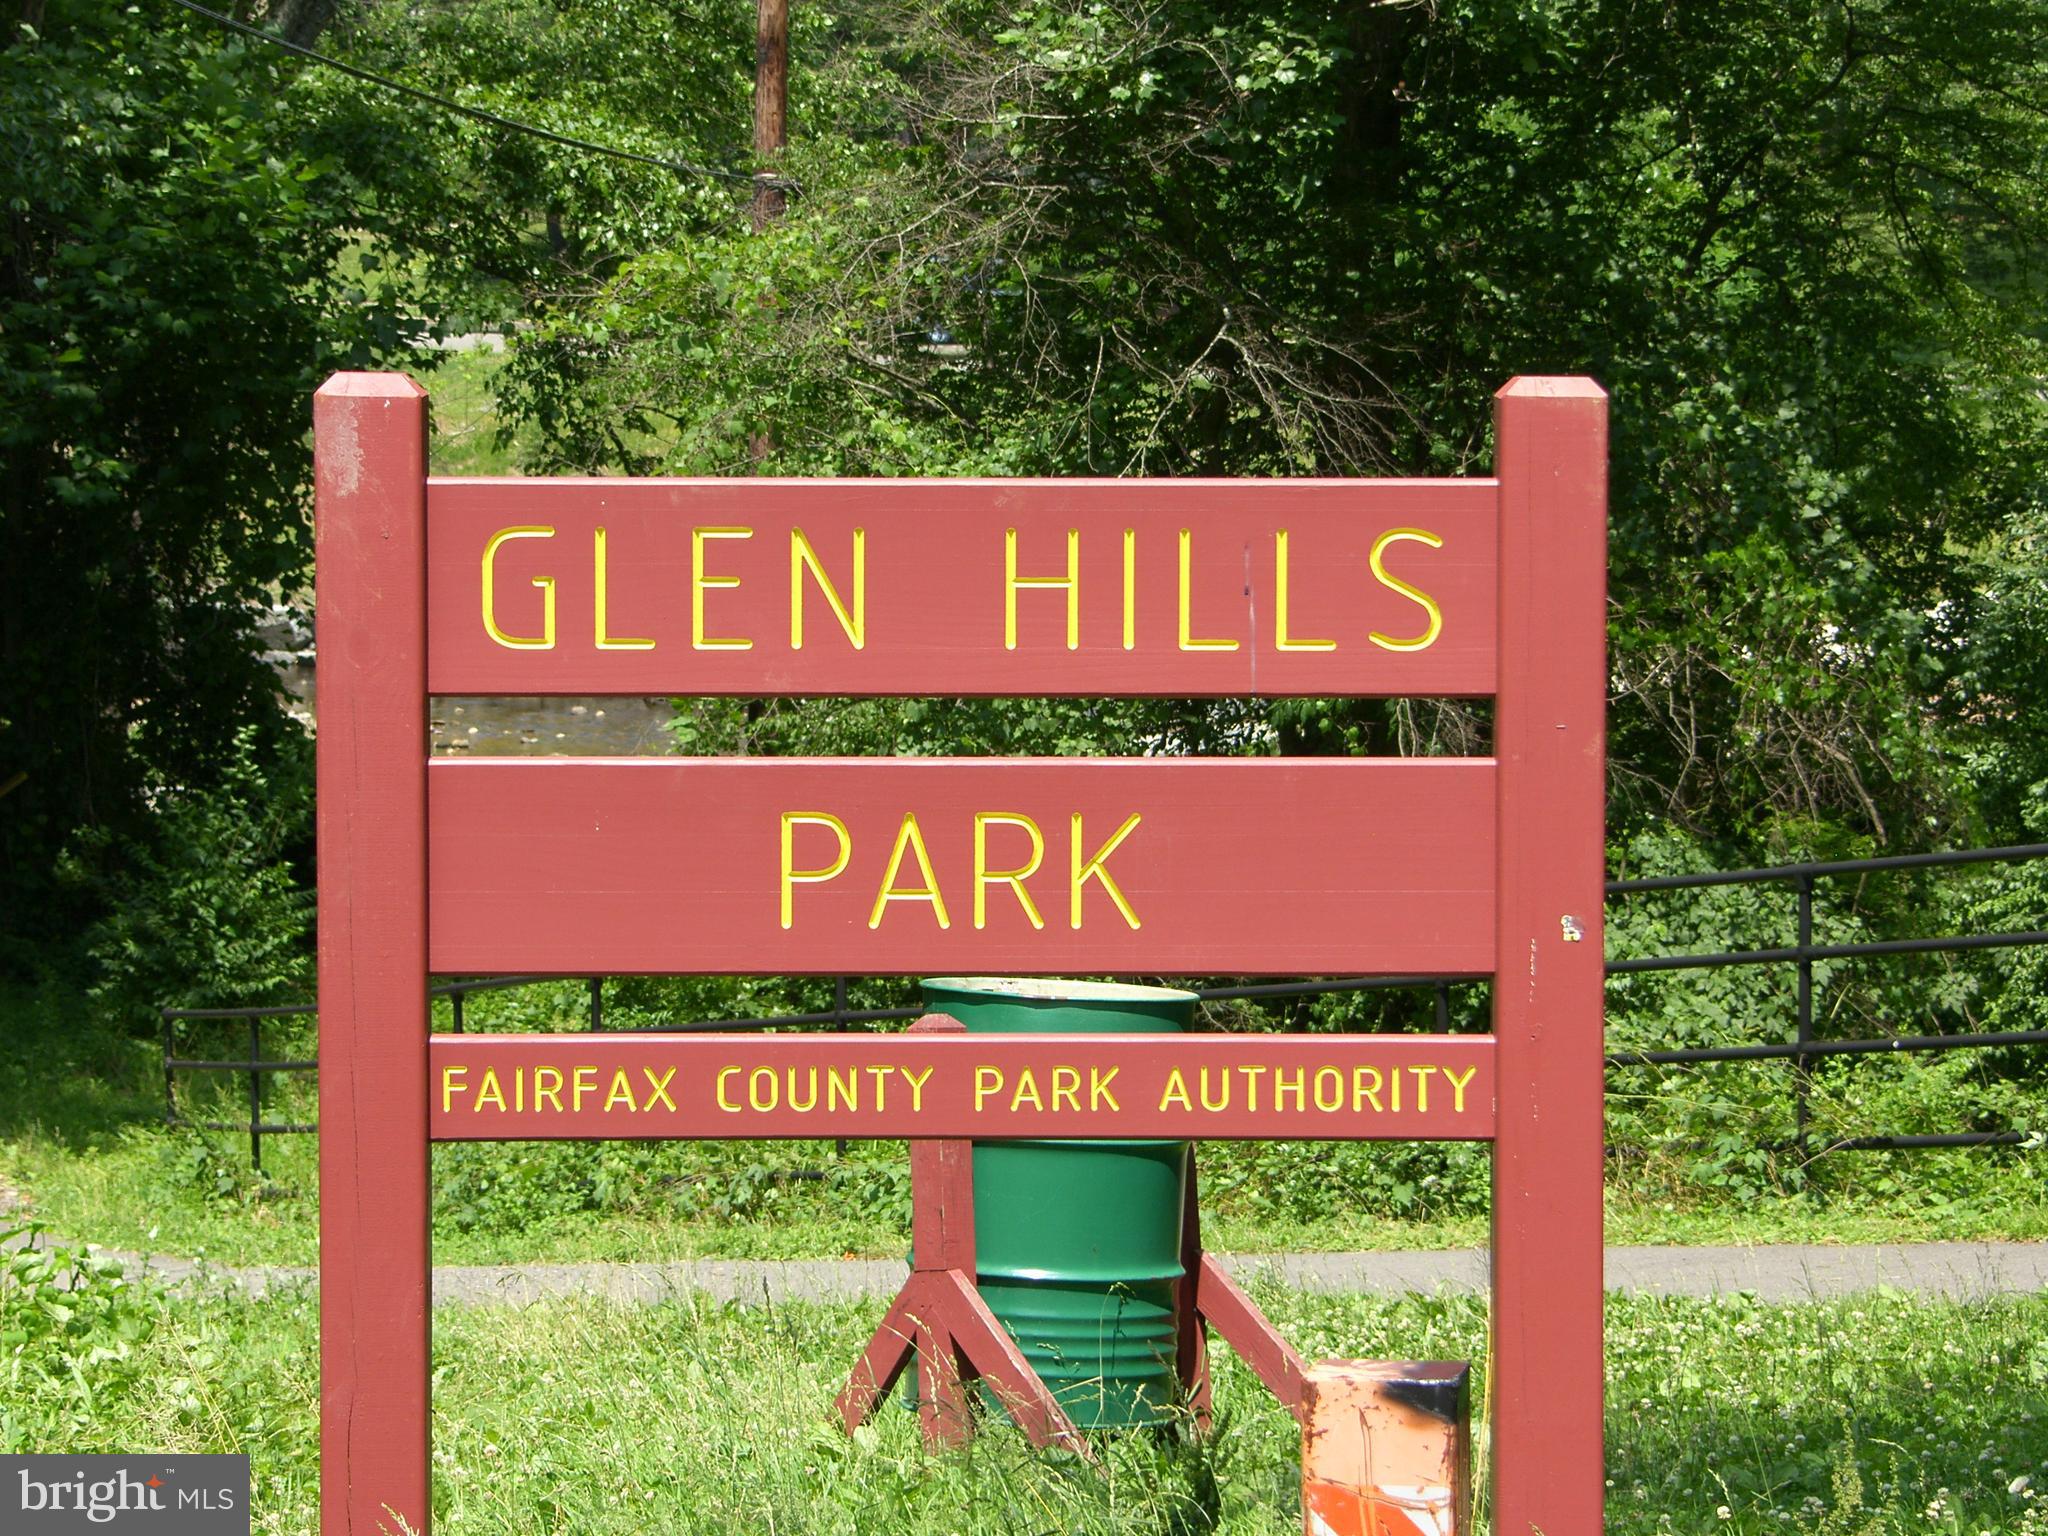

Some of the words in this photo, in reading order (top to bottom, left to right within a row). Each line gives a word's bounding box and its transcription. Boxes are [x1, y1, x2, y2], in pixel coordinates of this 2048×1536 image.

[480, 524, 867, 652] GLEN
[1003, 527, 1445, 654] HILLS
[779, 810, 1143, 931] PARK
[441, 1065, 678, 1114] FAIRFAX
[715, 1064, 935, 1114] COUNTY
[973, 1064, 1121, 1114] PARK
[1157, 1064, 1479, 1114] AUTHORITY
